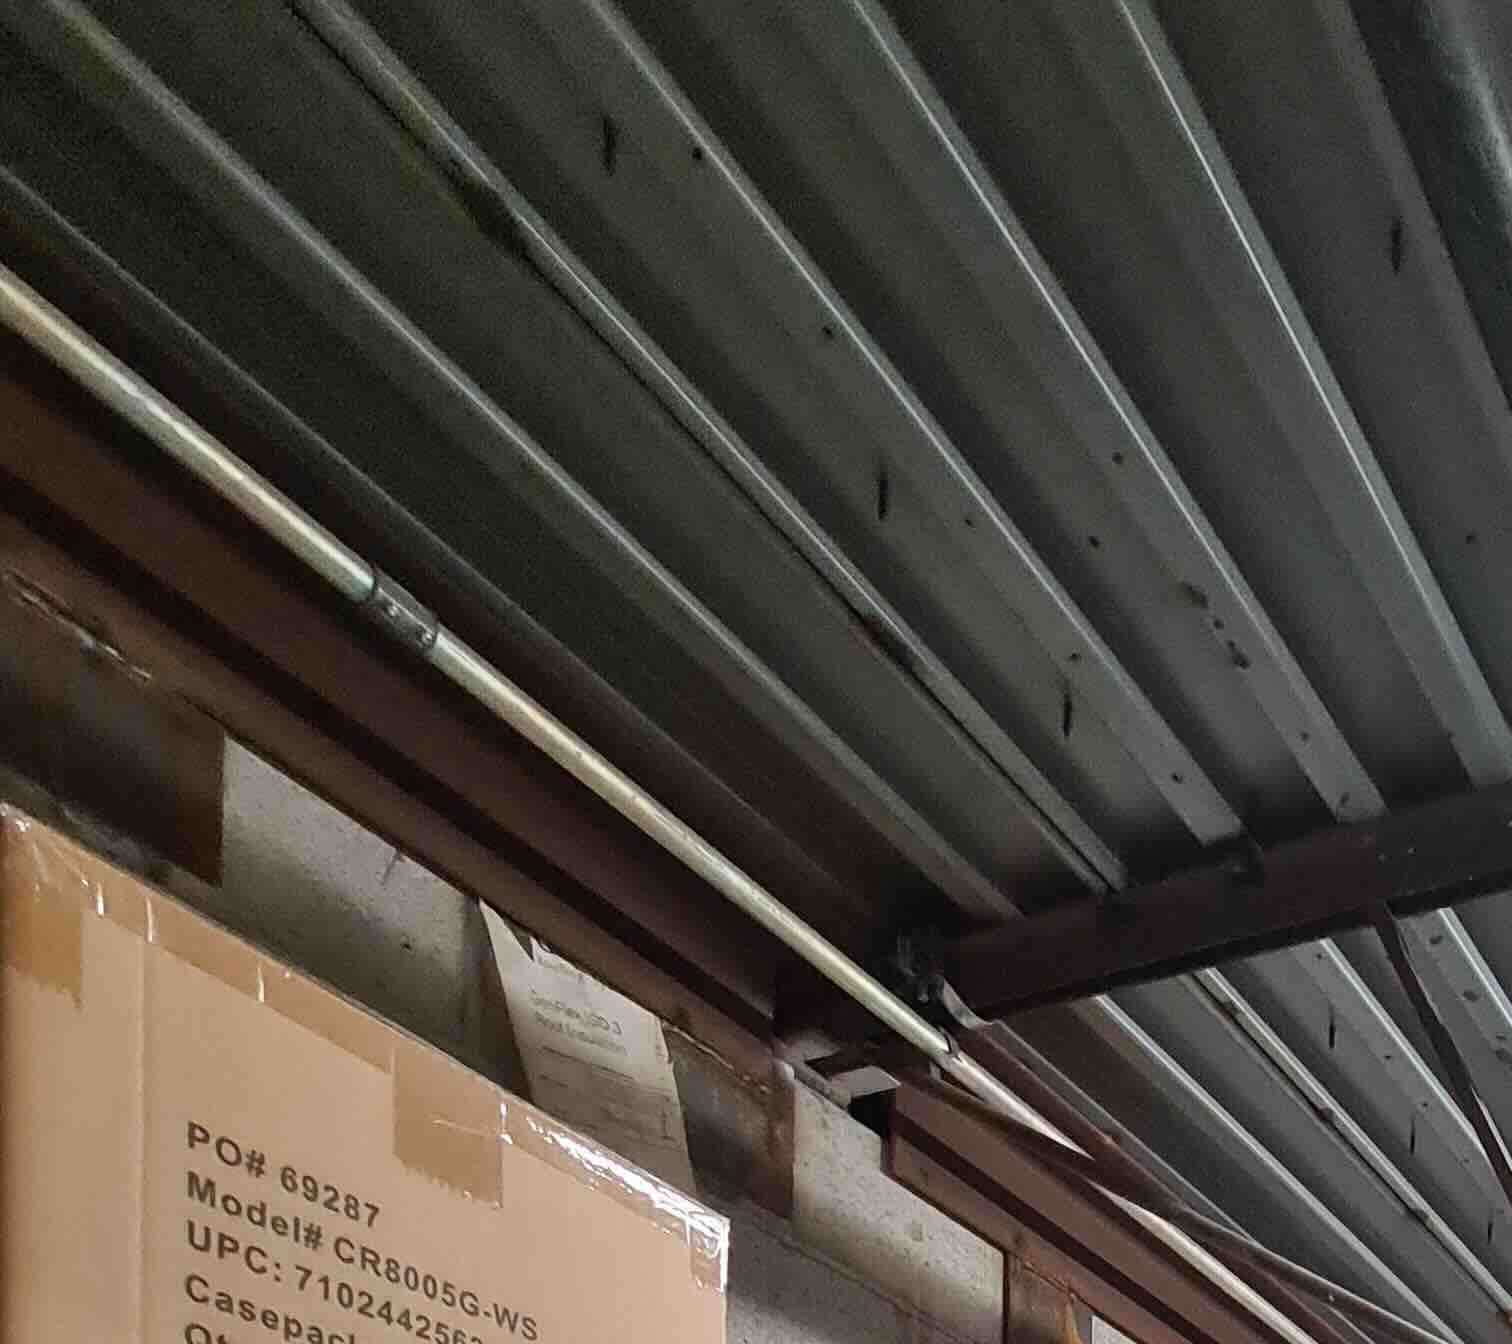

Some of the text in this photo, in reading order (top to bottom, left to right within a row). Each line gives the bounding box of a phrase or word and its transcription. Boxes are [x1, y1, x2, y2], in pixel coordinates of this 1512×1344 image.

[187, 1122, 379, 1227] PO# 69287
[187, 1219, 281, 1282] UPC:
[187, 1171, 537, 1340] Model# CR8005G-WS
